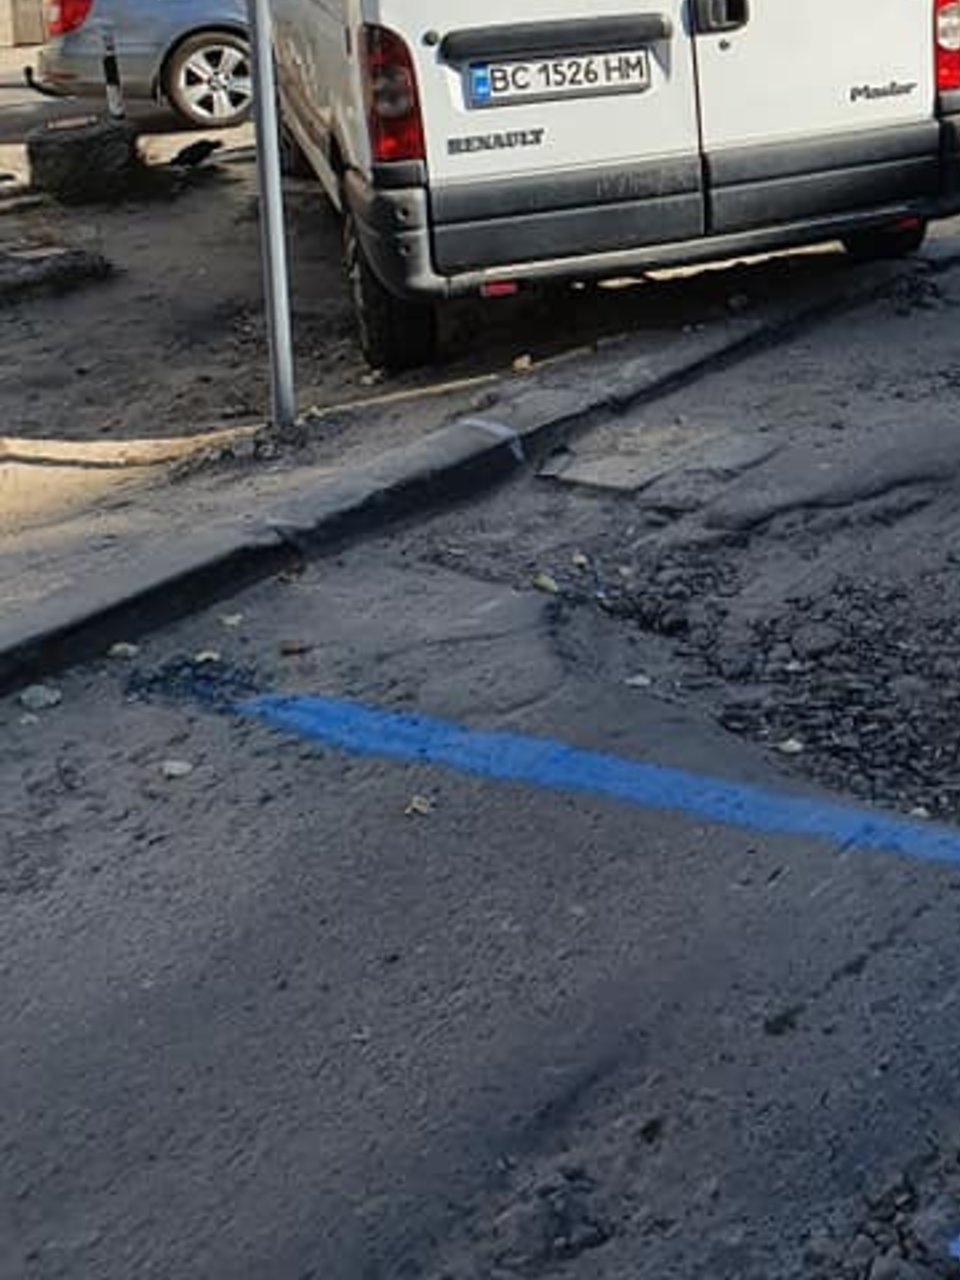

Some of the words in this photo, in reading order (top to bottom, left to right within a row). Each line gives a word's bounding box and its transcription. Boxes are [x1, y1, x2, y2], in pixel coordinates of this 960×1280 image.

[490, 66, 530, 92] BC
[538, 60, 599, 87] 1526
[605, 56, 644, 81] HM
[849, 81, 917, 102] Master
[447, 129, 544, 155] RENAULT
